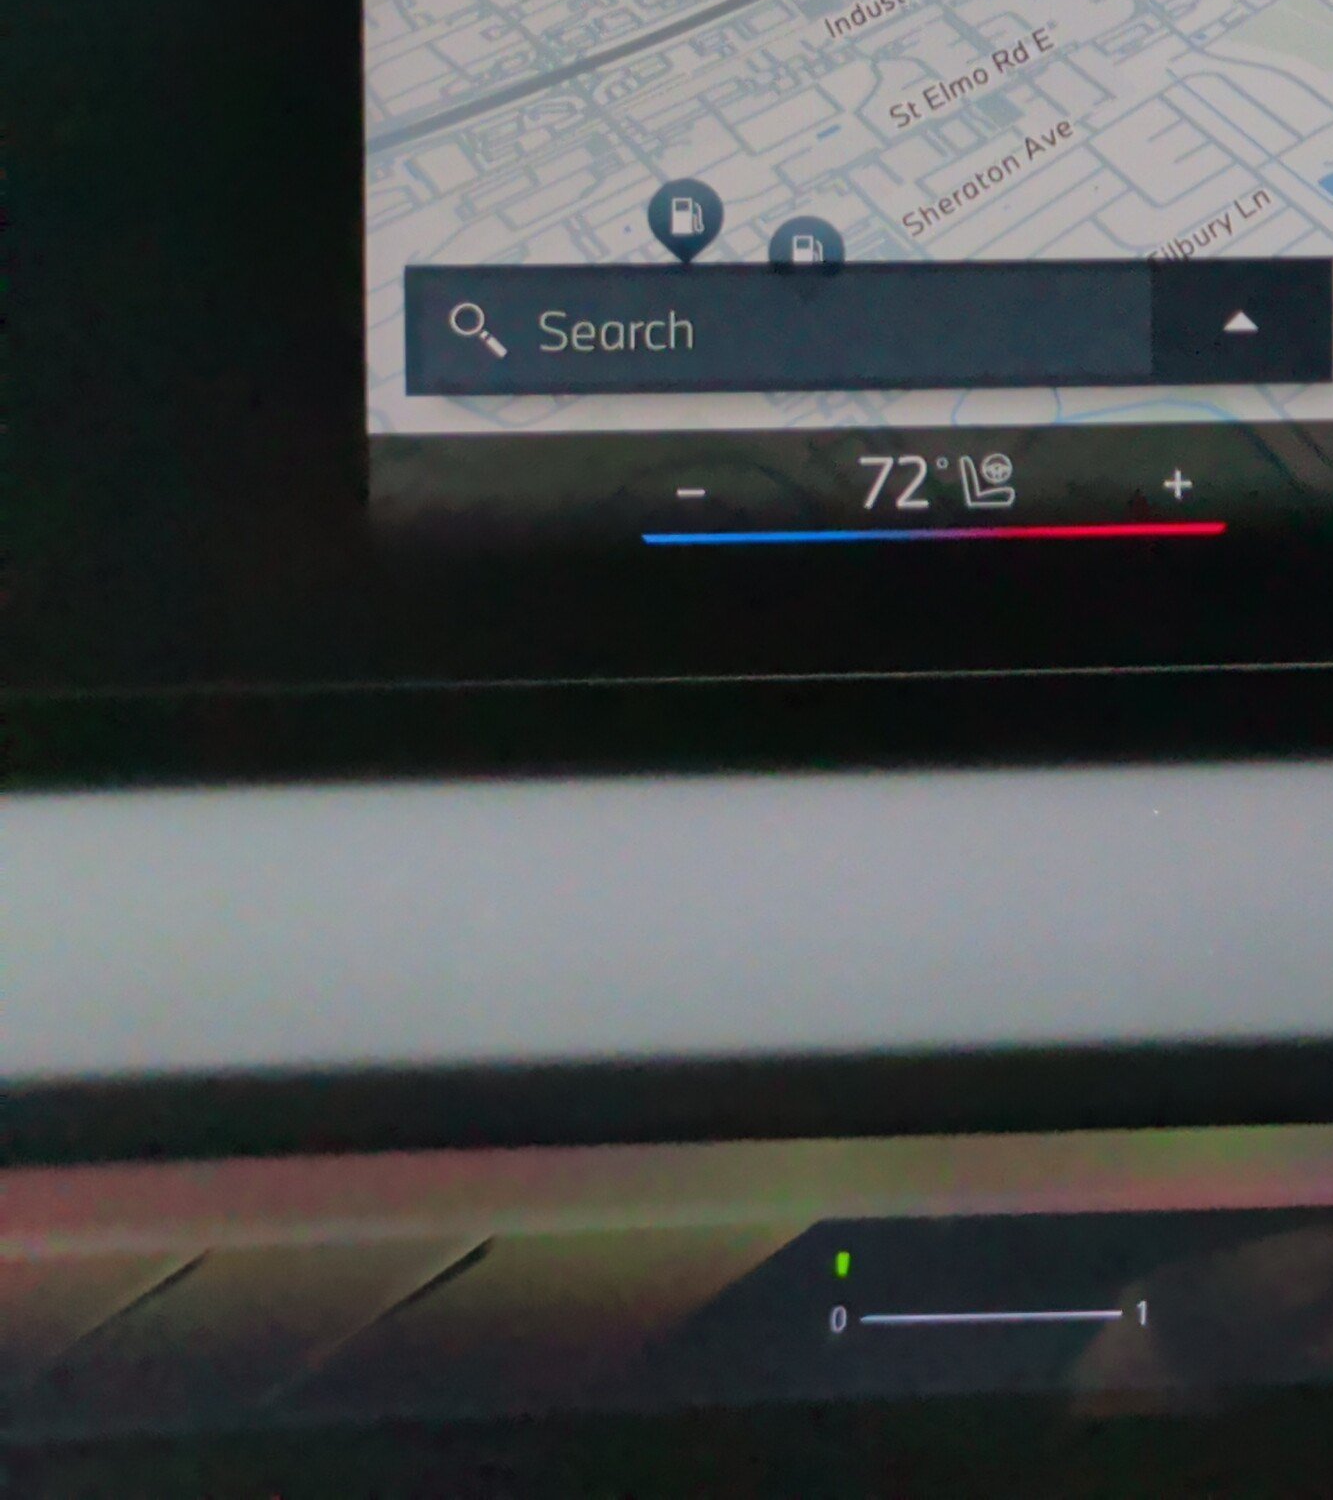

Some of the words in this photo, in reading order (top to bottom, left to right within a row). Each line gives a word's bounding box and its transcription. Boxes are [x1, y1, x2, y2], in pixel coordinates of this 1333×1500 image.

[889, 101, 922, 128] St
[922, 67, 989, 111] Elmo
[991, 40, 1030, 73] Rd
[1031, 28, 1055, 52] E
[900, 153, 1023, 238] Sheraton
[1023, 118, 1075, 162] Ave
[1234, 189, 1271, 218] Ln
[538, 310, 695, 354] Search
[830, 1305, 848, 1333] 0
[1136, 1299, 1148, 1326] 1
